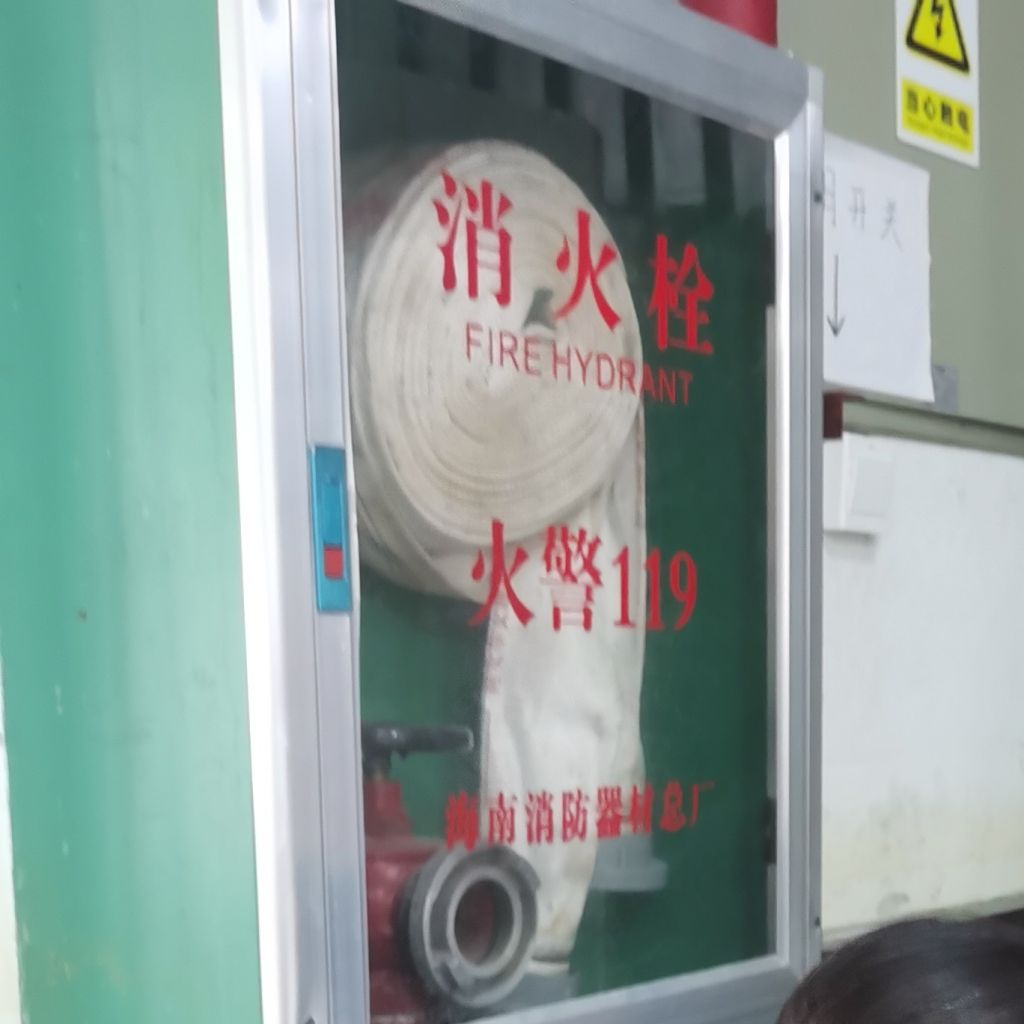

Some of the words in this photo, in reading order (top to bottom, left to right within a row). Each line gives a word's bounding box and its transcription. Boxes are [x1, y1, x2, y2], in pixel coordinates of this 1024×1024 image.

[432, 167, 716, 356] 消火栓
[465, 321, 543, 378] FIRE
[551, 339, 694, 406] HYDRANT
[468, 518, 698, 633] 火警119
[443, 779, 717, 851] 海南消防器材总厂
